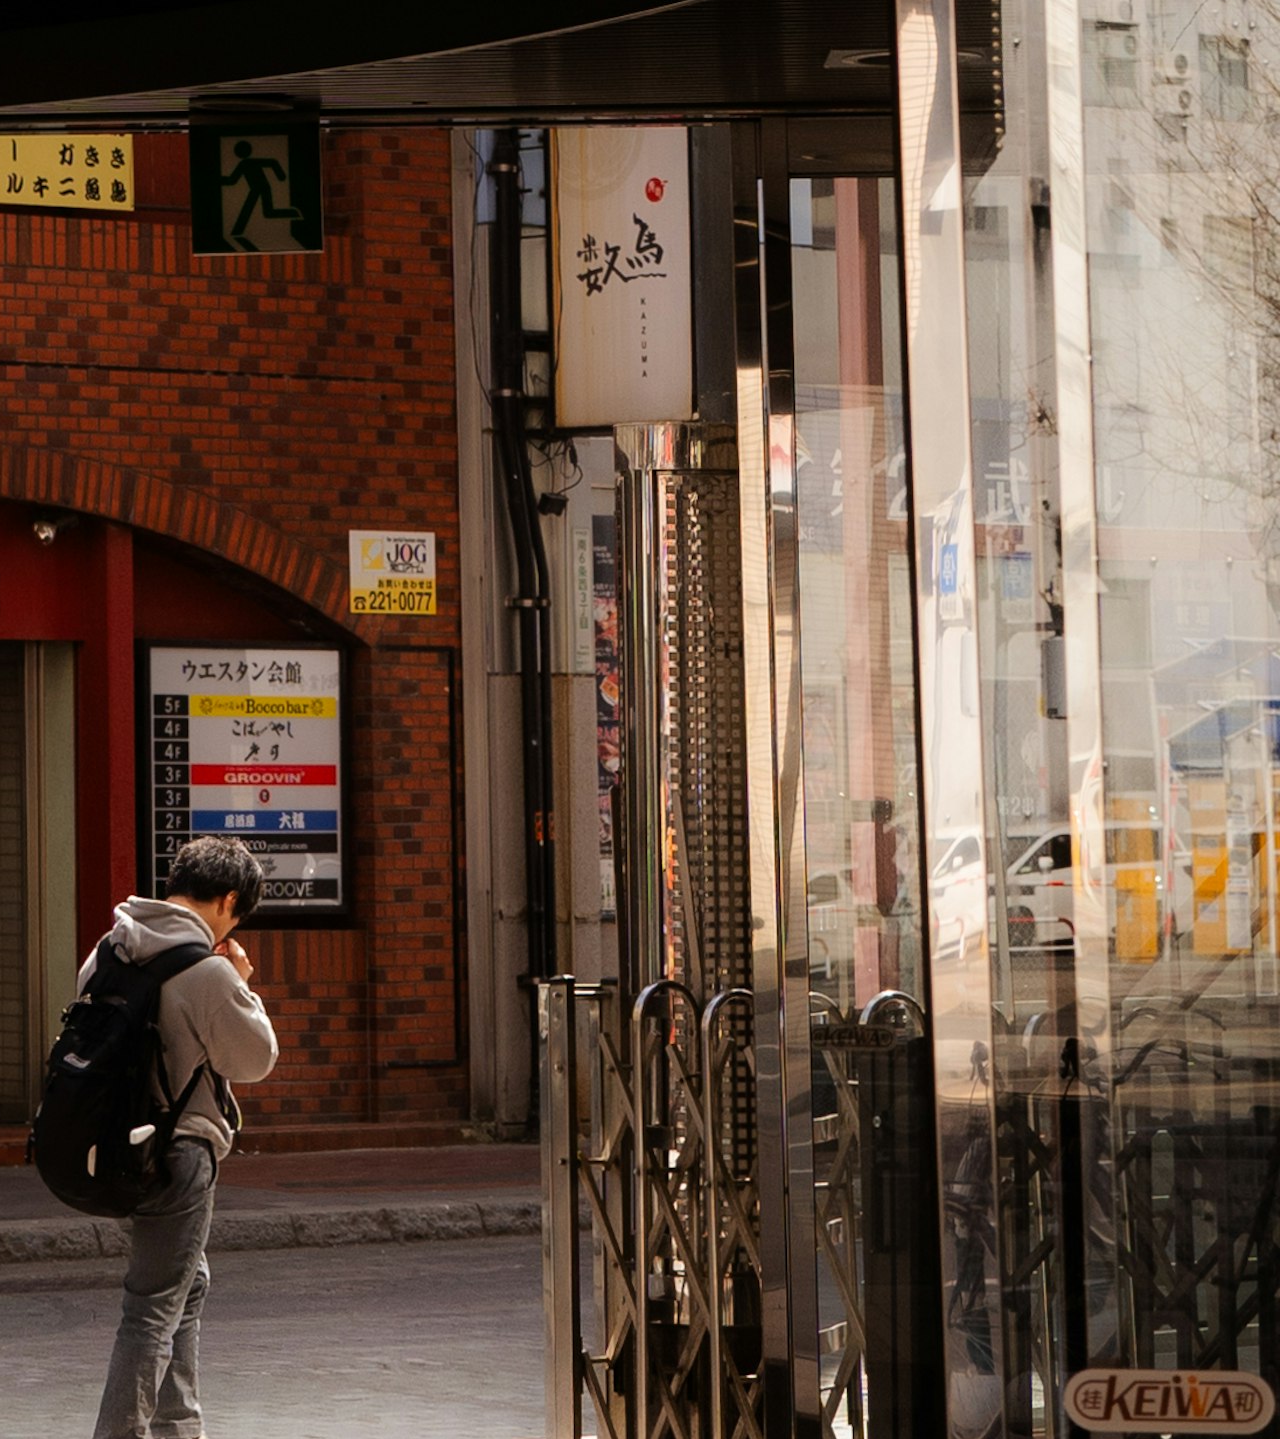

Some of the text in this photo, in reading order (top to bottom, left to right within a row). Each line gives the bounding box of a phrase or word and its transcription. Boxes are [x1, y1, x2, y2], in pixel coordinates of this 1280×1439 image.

[576, 213, 667, 297] 数馬
[640, 297, 648, 379] KAZUMA
[387, 543, 427, 564] JOG
[182, 660, 303, 685] ウエスタン会館
[164, 697, 181, 714] 5F
[164, 721, 182, 736] 4F
[164, 744, 182, 759] 4F
[165, 766, 182, 782] 3F
[165, 790, 182, 806] 3F
[165, 813, 182, 829] 2F
[278, 812, 306, 830] 大福
[262, 882, 314, 897] ROOVE
[1082, 1375, 1255, 1421] 桂 KEIWA 和
